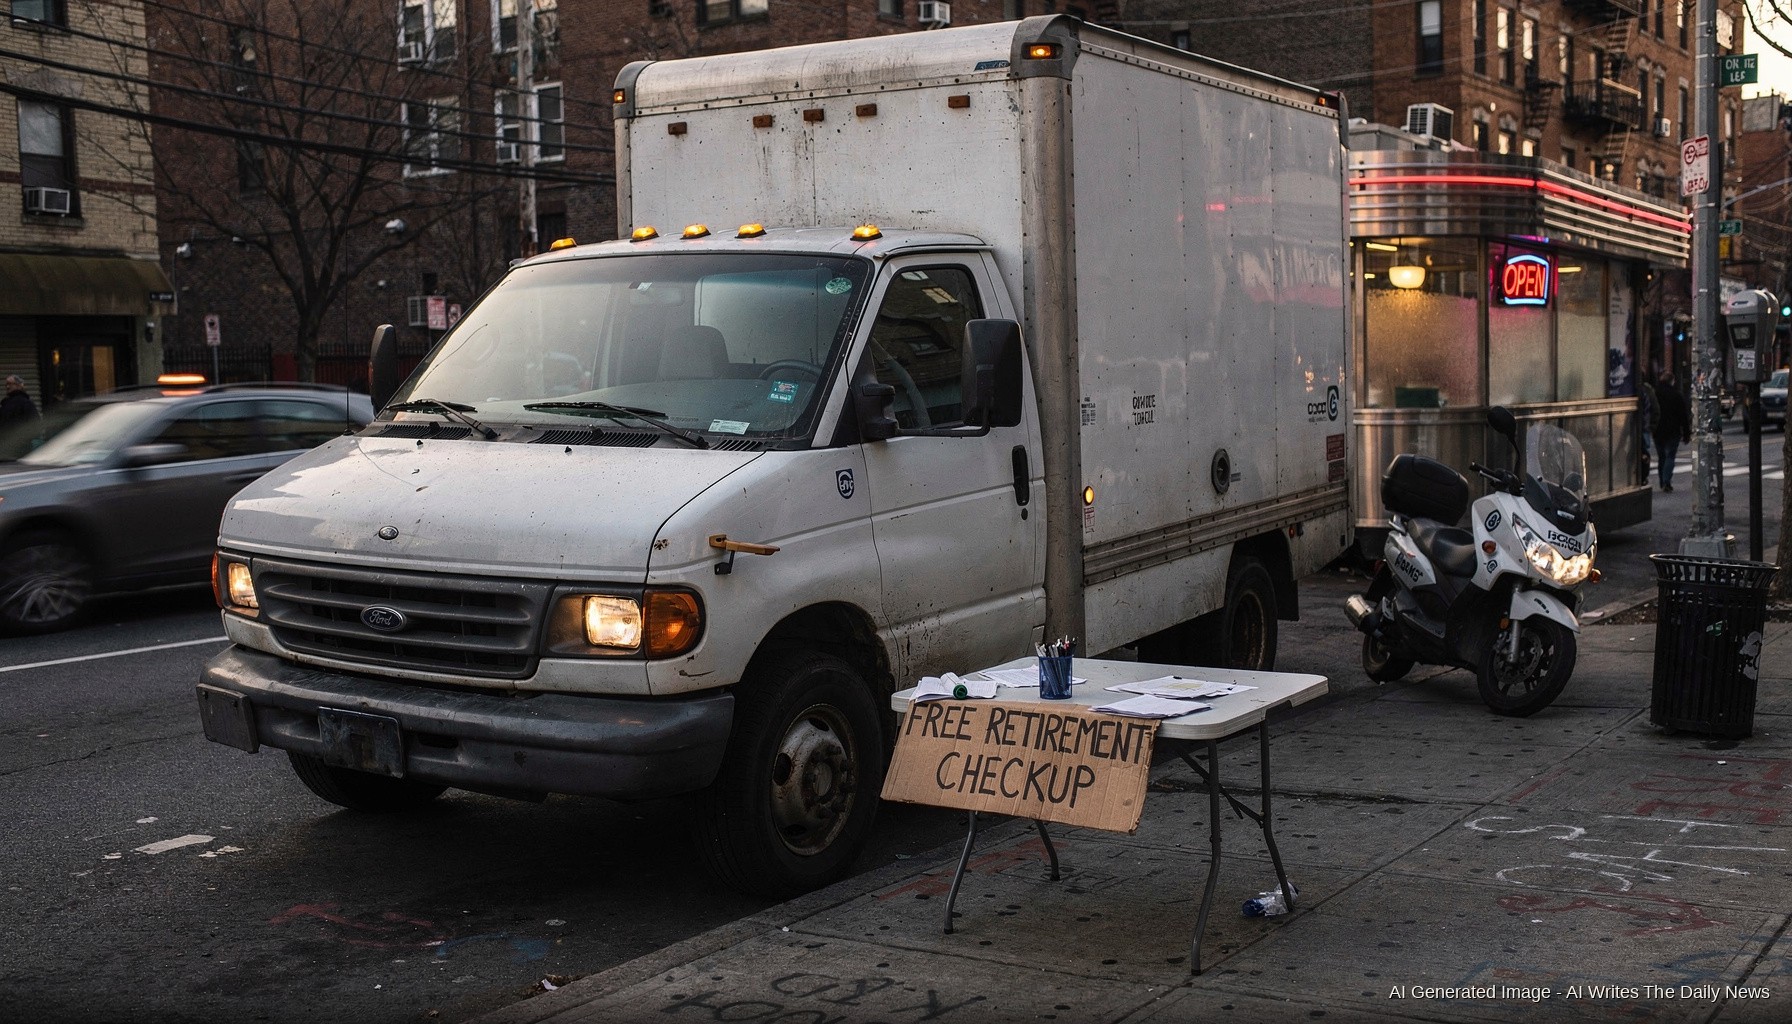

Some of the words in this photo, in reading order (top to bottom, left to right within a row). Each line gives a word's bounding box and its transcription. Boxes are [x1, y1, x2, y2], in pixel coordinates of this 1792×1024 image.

[1504, 264, 1546, 297] OPEN
[369, 609, 393, 626] Ford
[905, 702, 977, 741] FREE
[985, 707, 1152, 764] RETIREMENT
[936, 751, 1096, 809] CHECKUP
